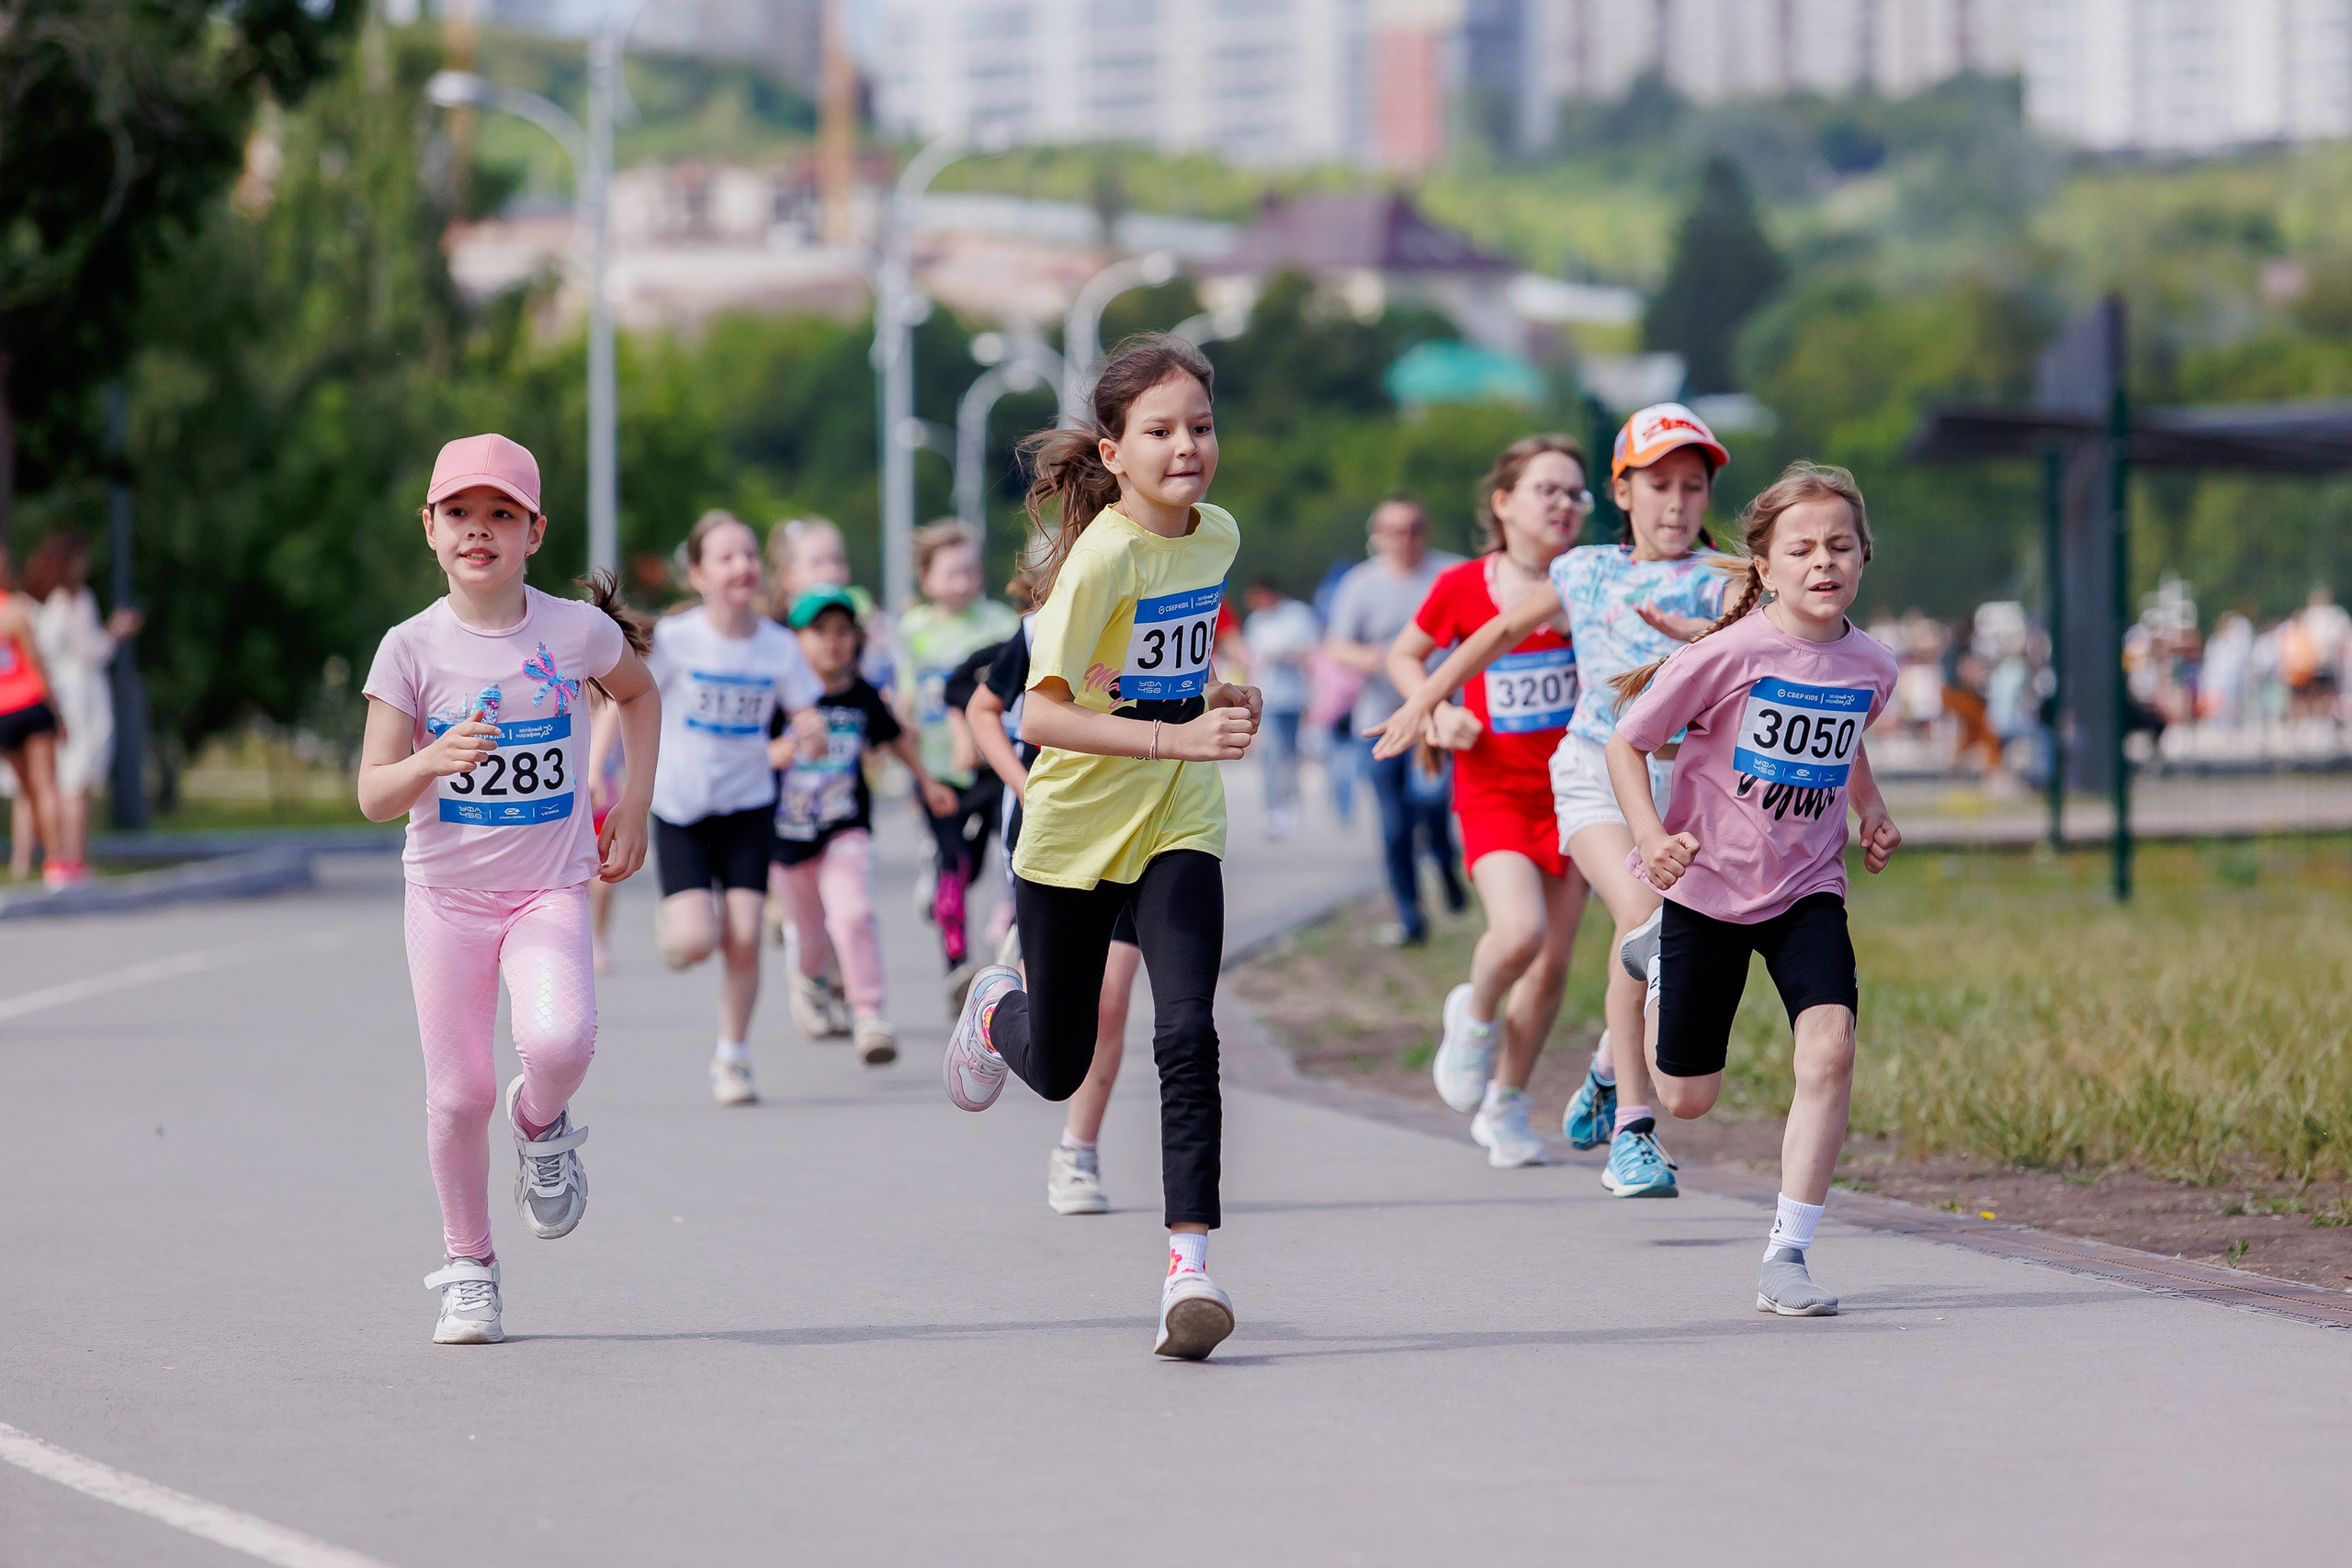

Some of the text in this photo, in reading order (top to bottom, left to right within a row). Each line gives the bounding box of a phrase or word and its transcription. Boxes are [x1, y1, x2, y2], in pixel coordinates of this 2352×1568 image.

[1498, 670, 1578, 708] 3207
[1787, 691, 1818, 702] СБЕР KIDS
[1753, 708, 1855, 759] 3050
